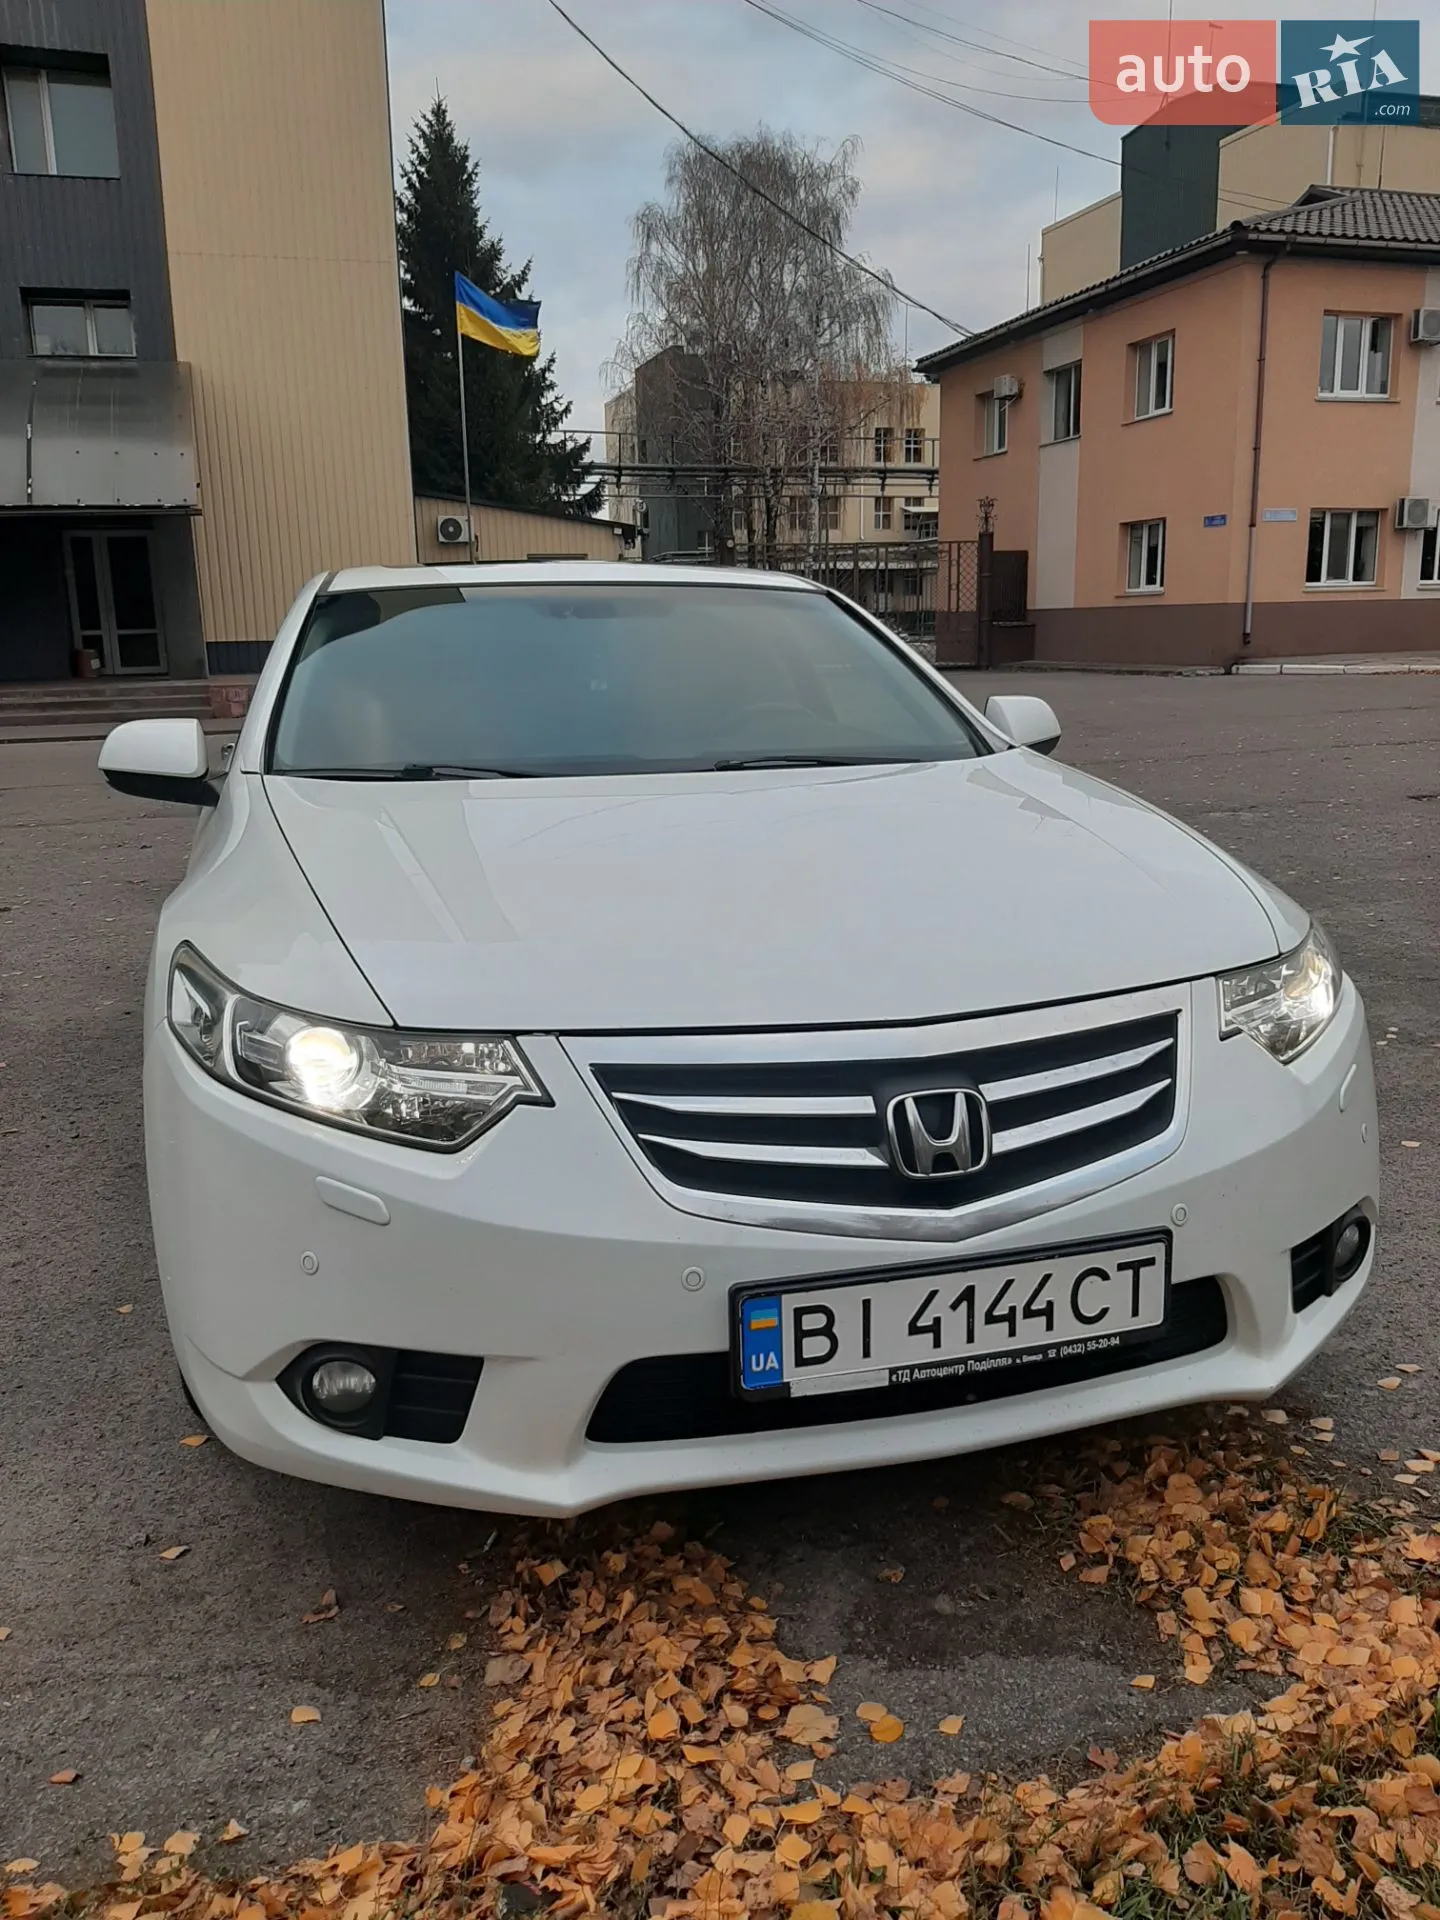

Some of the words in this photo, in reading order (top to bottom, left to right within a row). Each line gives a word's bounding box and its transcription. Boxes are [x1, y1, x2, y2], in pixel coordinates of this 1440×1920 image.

[751, 1351, 779, 1372] UA
[912, 1363, 966, 1380] Автоцентр
[1060, 1343, 1085, 1358] (0432)
